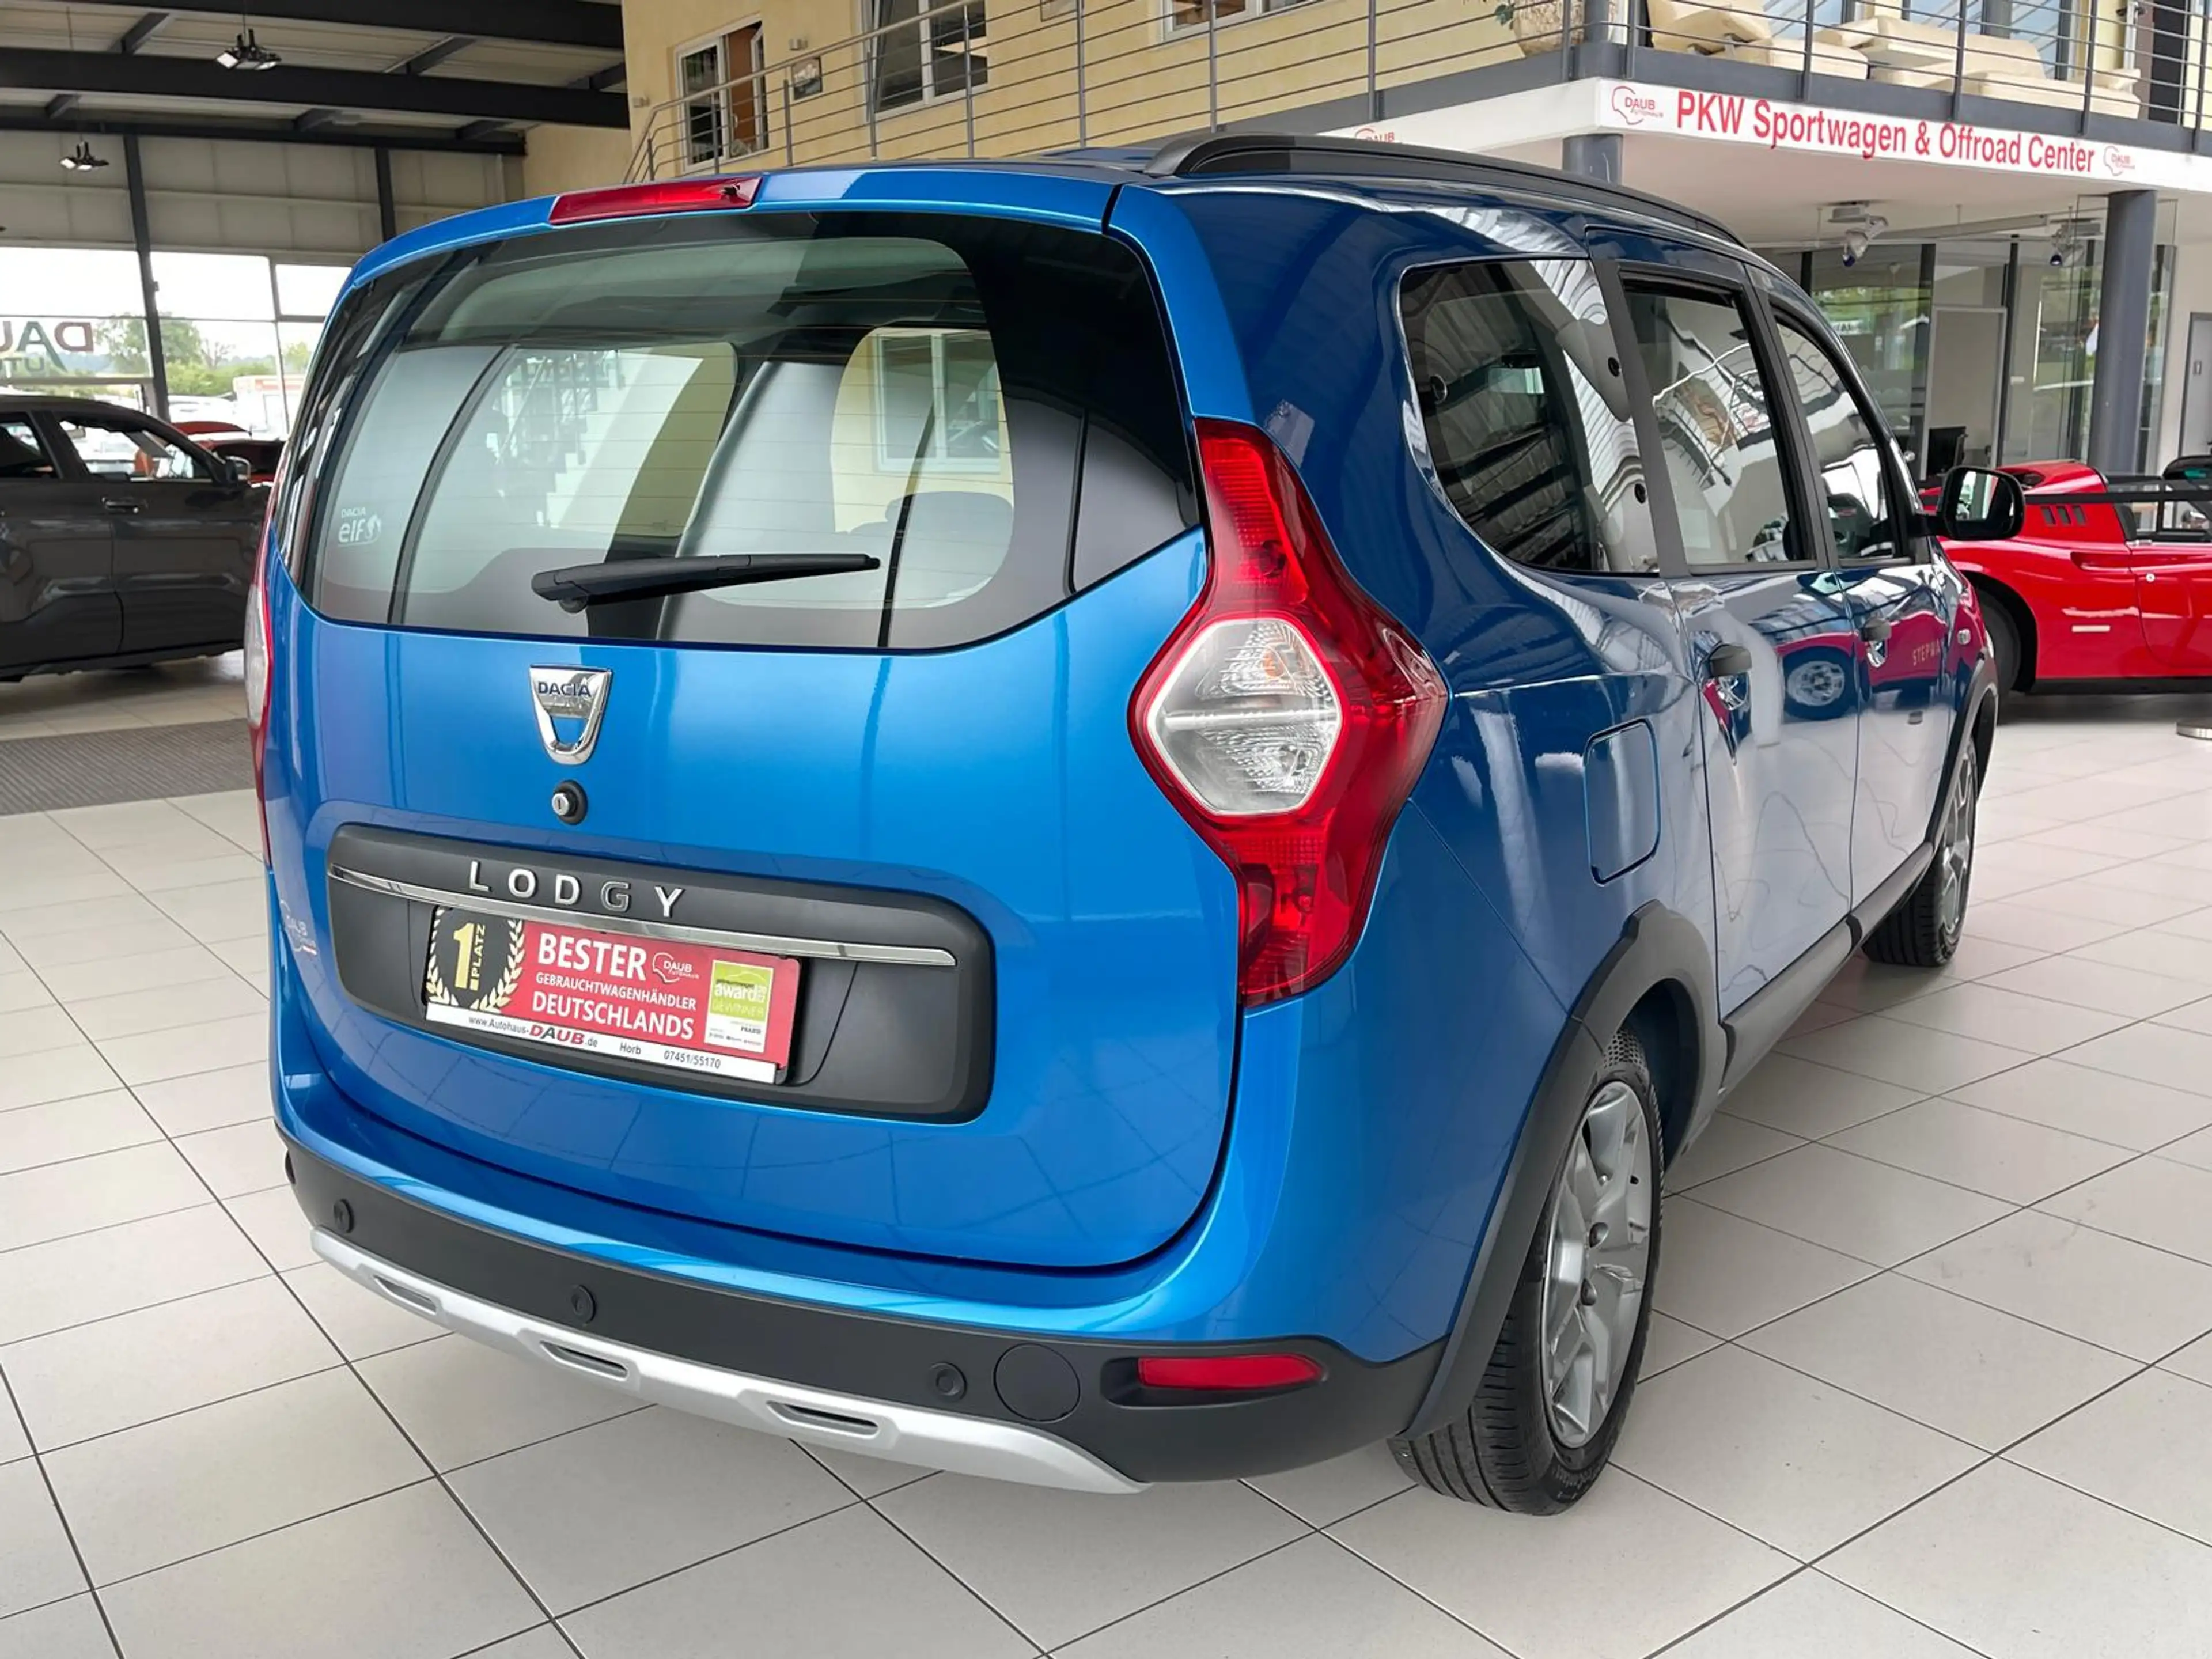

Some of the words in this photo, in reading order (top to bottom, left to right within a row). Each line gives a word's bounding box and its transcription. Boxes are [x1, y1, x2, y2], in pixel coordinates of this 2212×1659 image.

[1624, 97, 1656, 110] DAUB
[1677, 90, 1745, 134] PKW
[1753, 99, 1906, 159] Sportwagen
[1915, 120, 1930, 156] &
[1939, 122, 2021, 165] Offroad
[2028, 135, 2095, 172] Center
[338, 518, 366, 543] elf
[538, 681, 592, 697] DACIA
[469, 861, 685, 918] LODGY
[472, 923, 486, 978] PLATZ
[537, 931, 647, 981] BESTER
[663, 960, 692, 973] DAUB
[535, 972, 696, 1011] GEBRAUCHTWAGENHÄNDLER
[715, 982, 759, 1002] award
[532, 990, 694, 1040] DEUTSCHLANDS
[619, 1042, 641, 1055] Horb
[664, 1050, 721, 1069] 07451/55170
